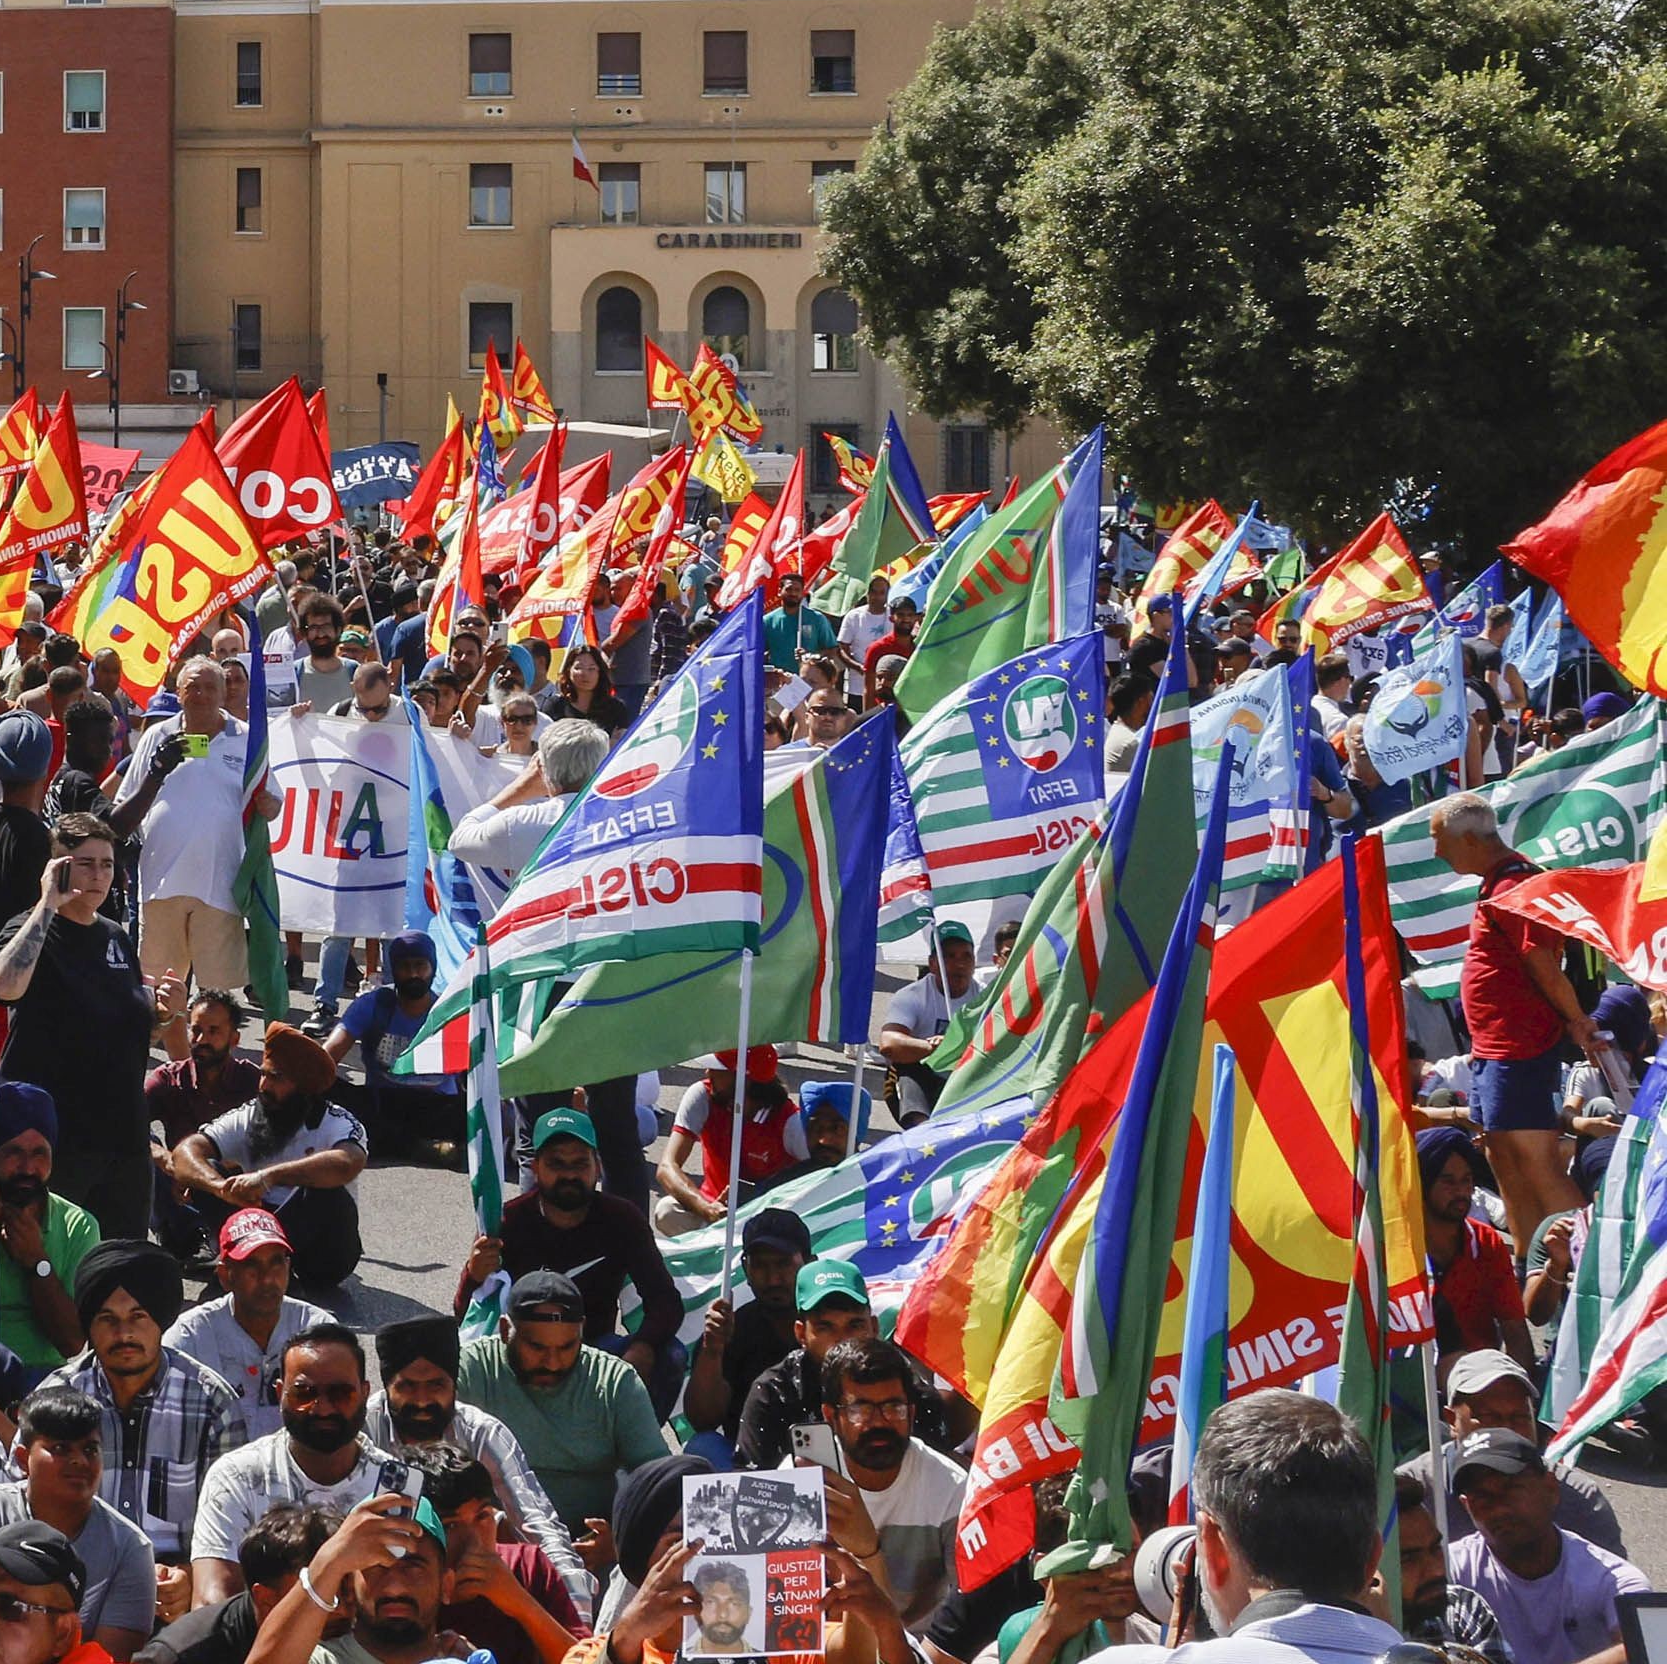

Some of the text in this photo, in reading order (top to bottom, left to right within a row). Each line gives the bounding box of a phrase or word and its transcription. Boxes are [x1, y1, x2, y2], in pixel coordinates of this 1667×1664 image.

[656, 232, 802, 250] CARABINIERI
[717, 450, 748, 486] Rete
[750, 1480, 779, 1492] JUSTICE
[757, 1489, 772, 1499] FOR
[738, 1494, 790, 1511] SATNAM SINGH
[783, 1575, 808, 1587] PER
[767, 1589, 820, 1603] SATNAM
[773, 1603, 813, 1616] SINGH
